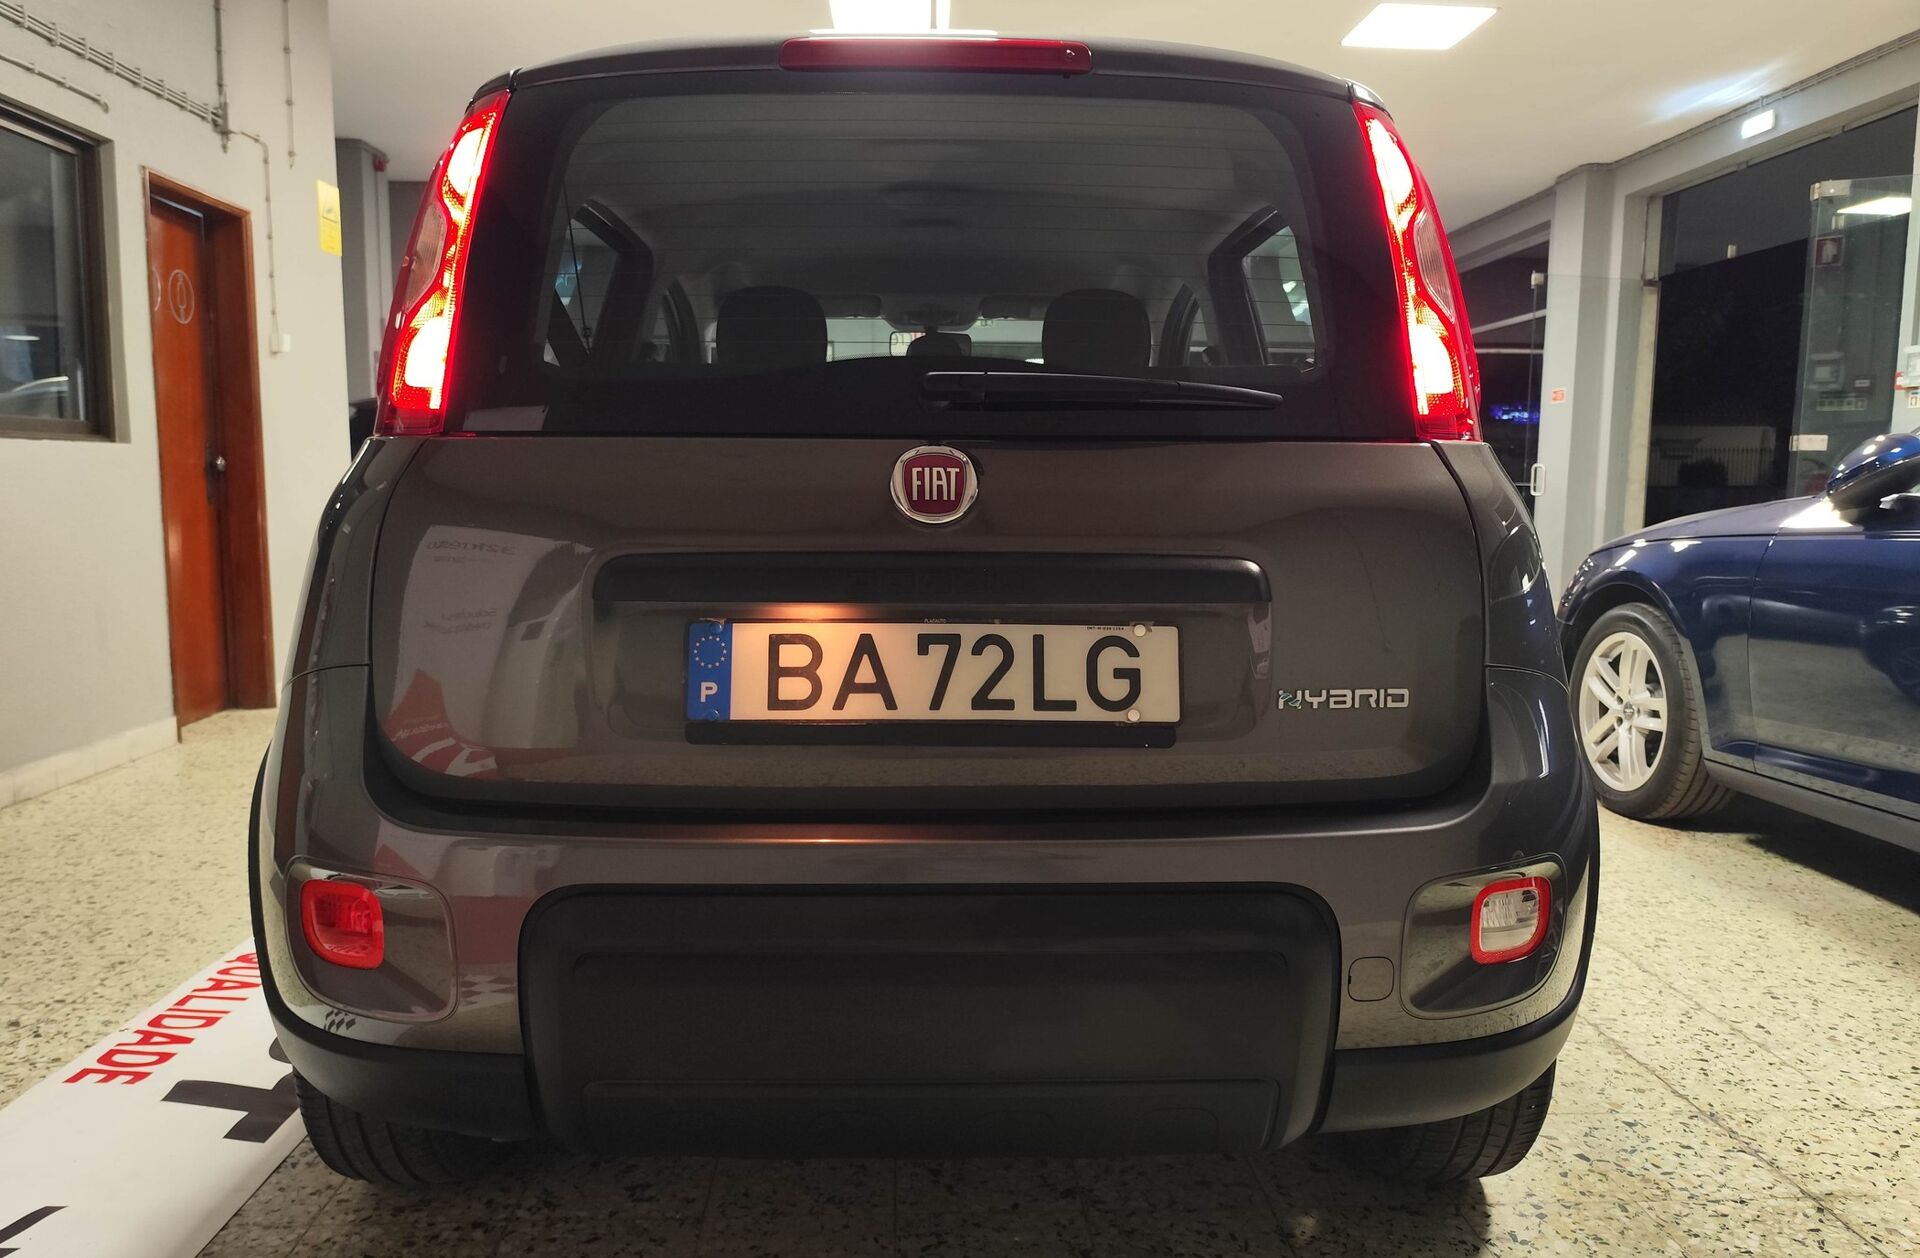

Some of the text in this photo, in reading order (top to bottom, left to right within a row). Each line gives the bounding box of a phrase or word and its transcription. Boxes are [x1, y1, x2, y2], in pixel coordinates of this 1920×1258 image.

[911, 467, 960, 501] FIAT
[700, 682, 718, 703] P
[1278, 688, 1410, 710] HYBRID
